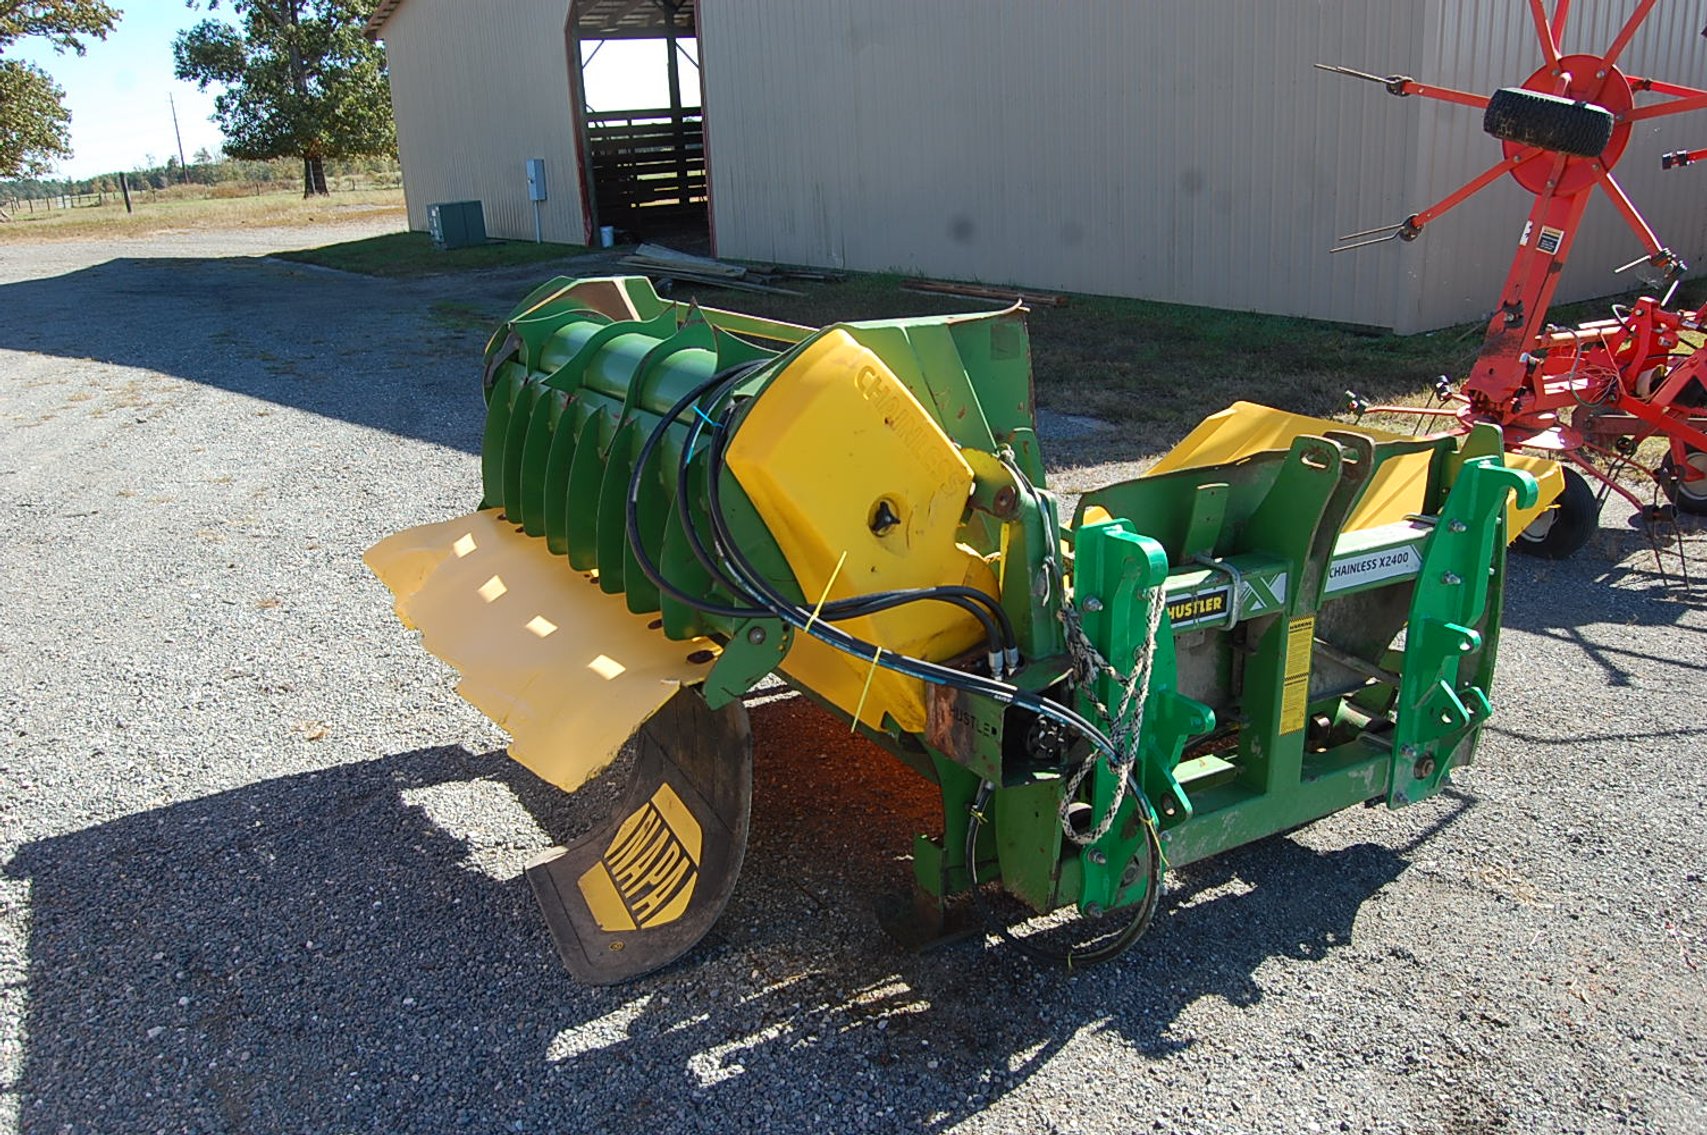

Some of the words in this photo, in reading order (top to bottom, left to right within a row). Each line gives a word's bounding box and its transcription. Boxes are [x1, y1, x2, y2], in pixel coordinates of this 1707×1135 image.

[854, 365, 965, 497] CHAINLESS
[1329, 558, 1377, 579] CHAINLESS
[1378, 551, 1409, 568] X2400
[1167, 596, 1222, 620] HUSTLER
[607, 809, 690, 920] NAPA
